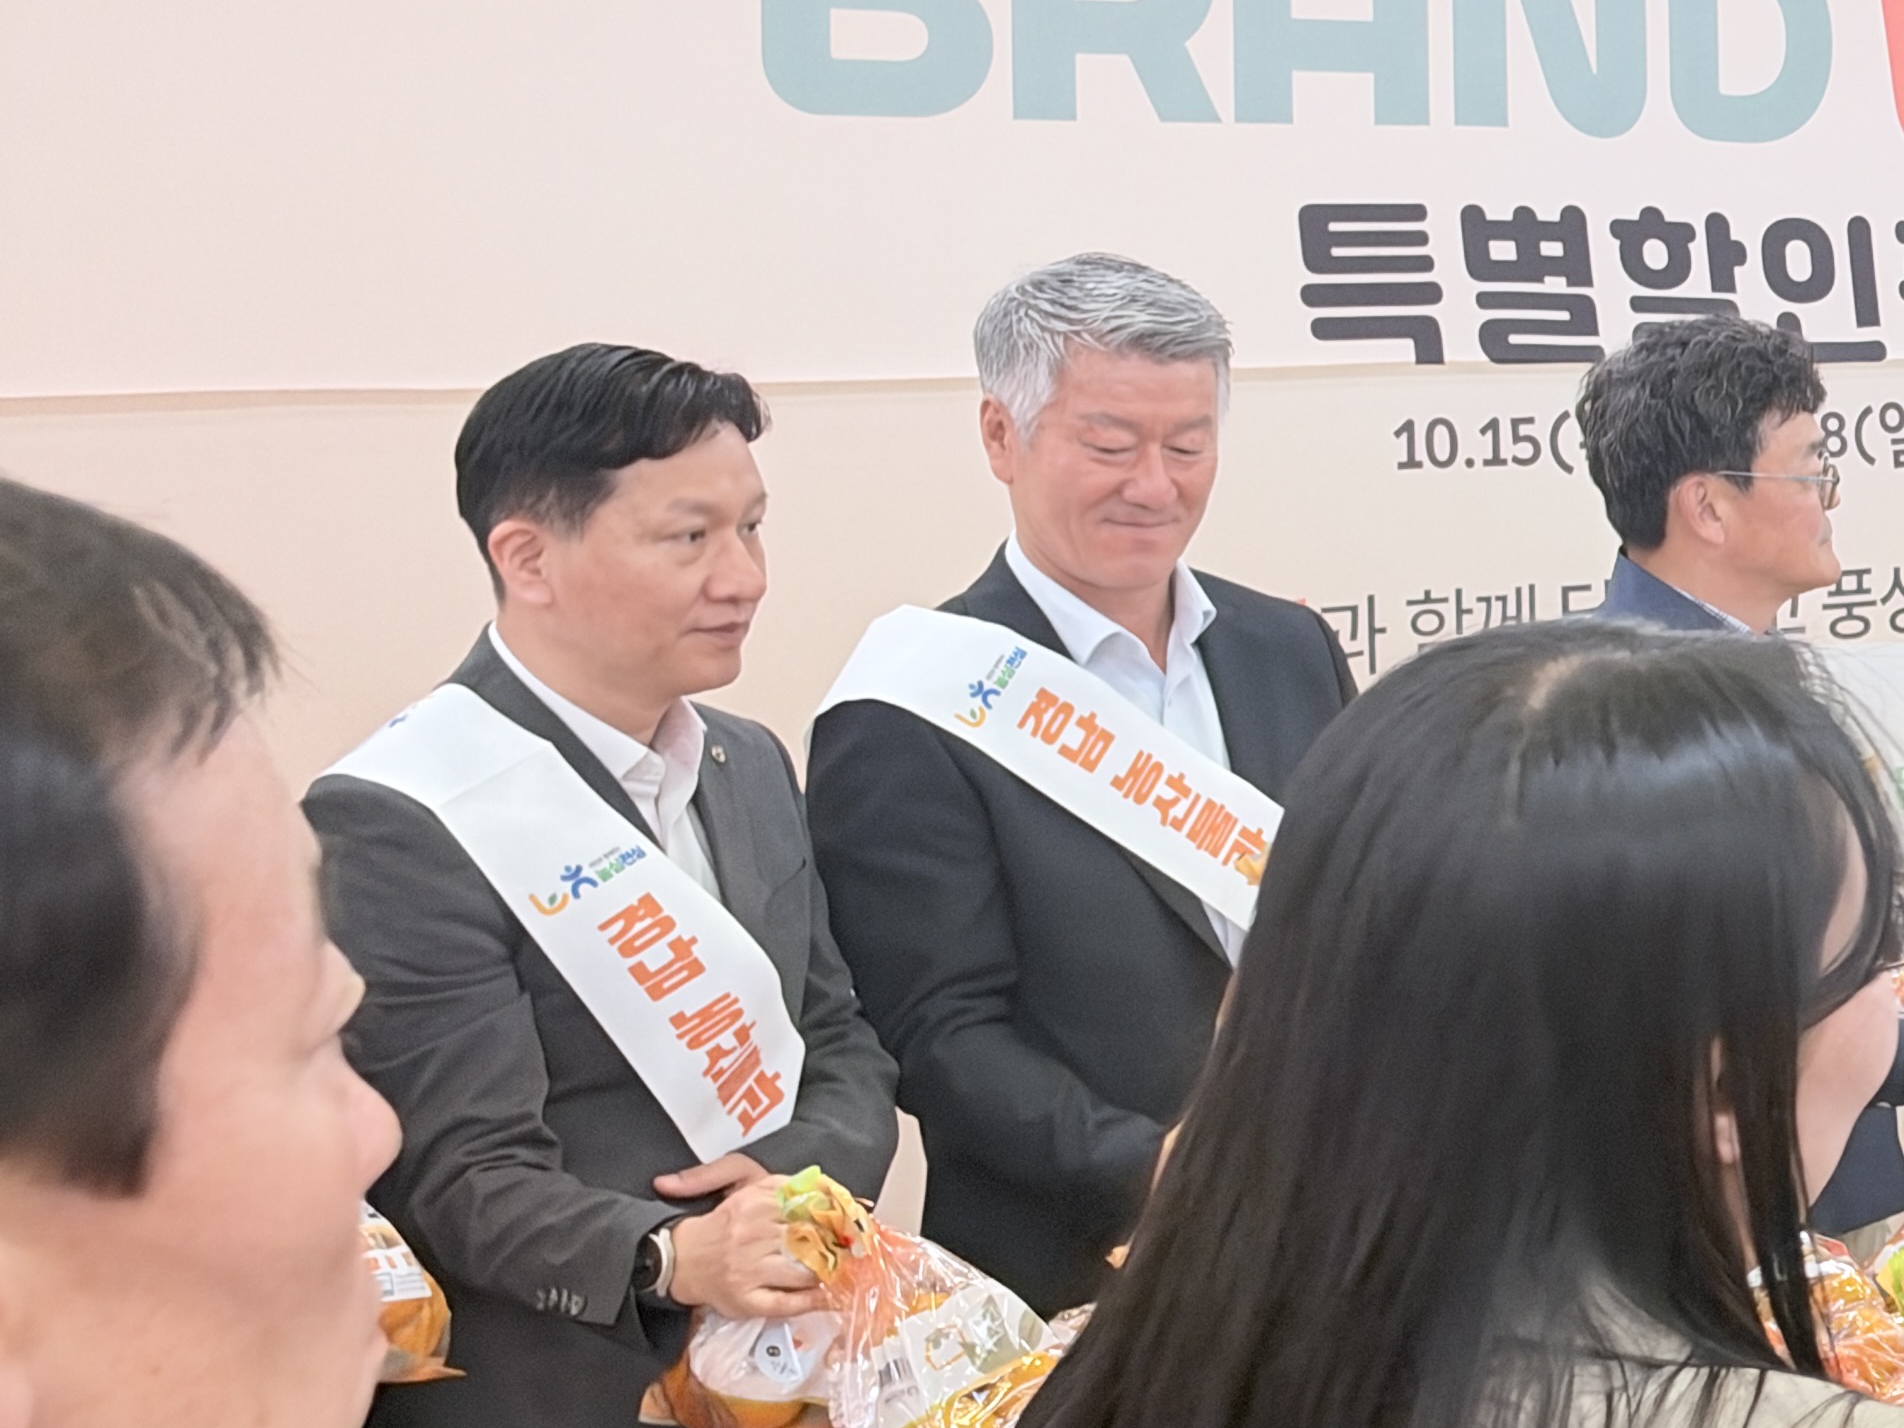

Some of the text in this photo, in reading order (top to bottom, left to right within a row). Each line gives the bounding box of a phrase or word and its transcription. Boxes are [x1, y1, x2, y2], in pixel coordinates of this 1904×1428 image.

[1392, 408, 1588, 476] 10.15(
[1016, 687, 1116, 774] 경남
[597, 891, 785, 1138] 경남 농산물과
